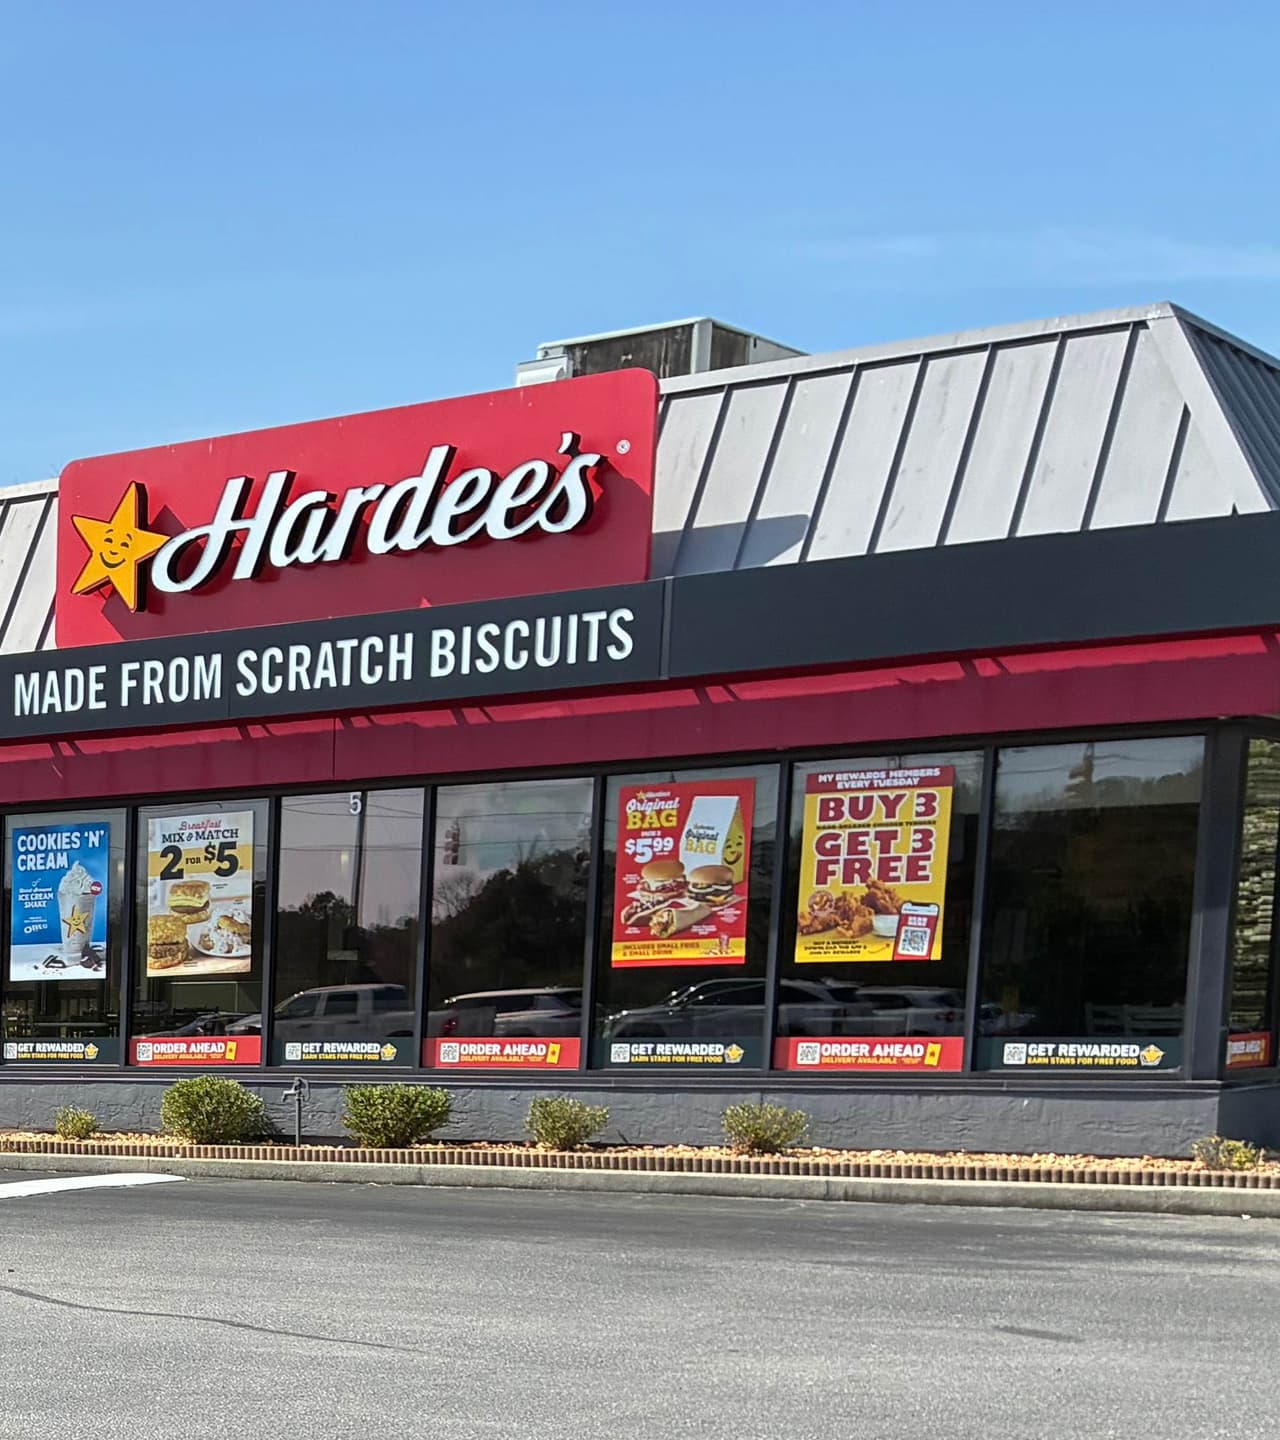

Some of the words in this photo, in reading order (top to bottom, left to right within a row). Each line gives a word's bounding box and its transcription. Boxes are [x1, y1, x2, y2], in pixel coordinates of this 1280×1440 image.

[151, 431, 601, 593] Hardee's
[14, 664, 107, 717] MADE
[121, 653, 223, 706] FROM
[236, 631, 415, 697] SCRATCH
[430, 608, 635, 677] BISCUITS
[818, 773, 834, 783] MY
[835, 771, 886, 781] REWARDS
[889, 768, 940, 778] MEMBERS
[837, 780, 871, 789] EVERY
[874, 777, 920, 788] TUESDAY
[626, 796, 680, 814] Original
[818, 792, 907, 822] BUY
[913, 791, 938, 819] 3
[626, 810, 678, 830] BAG
[17, 831, 81, 852] COOKIES
[162, 832, 185, 843] MIX
[195, 828, 239, 841] MATCH
[814, 829, 900, 857] GET
[911, 828, 935, 854] 3
[17, 852, 69, 871] CREAM
[159, 844, 184, 881] 2
[185, 856, 201, 865] FOR
[203, 841, 239, 877] $5
[814, 854, 932, 886] FREE
[18, 1042, 34, 1052] GET
[36, 1042, 85, 1052] REWARDED
[153, 1042, 187, 1053] ORDER
[189, 1042, 225, 1053] AHEAD
[302, 1043, 322, 1053] GET
[323, 1043, 380, 1053] REWARDED
[460, 1043, 501, 1055] ORDER
[503, 1043, 546, 1055] AHEAD
[631, 1043, 654, 1055] GET
[656, 1043, 724, 1055] REWARDED
[821, 1043, 870, 1057] ORDER
[872, 1043, 924, 1057] AHEAD
[1028, 1043, 1055, 1057] GET
[1057, 1043, 1140, 1057] REWARDED
